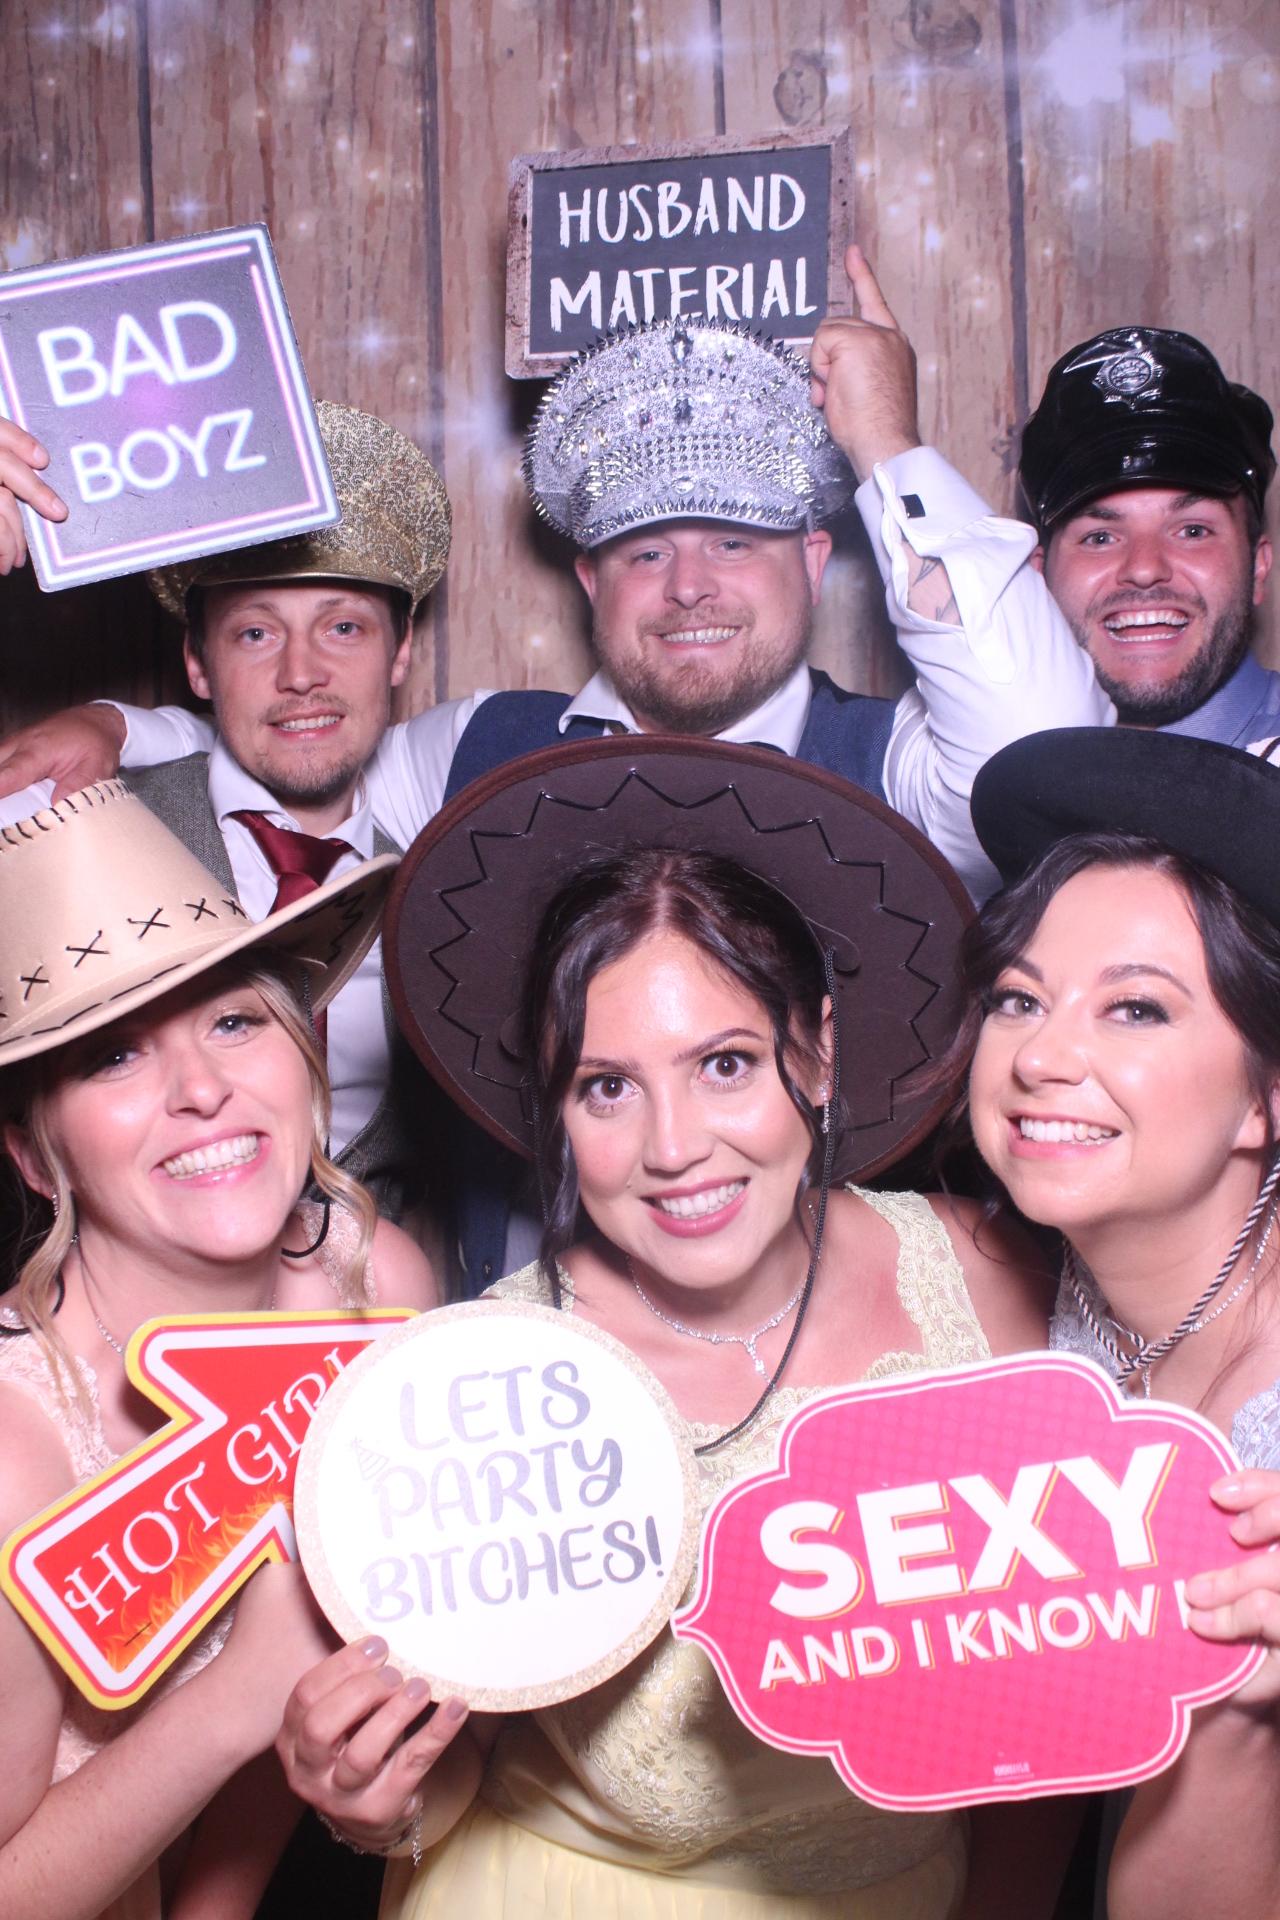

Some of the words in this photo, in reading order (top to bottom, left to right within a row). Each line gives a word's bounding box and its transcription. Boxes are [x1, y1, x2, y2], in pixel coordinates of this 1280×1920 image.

[559, 173, 806, 248] HUSBAND
[550, 257, 817, 333] MATERIAL
[37, 301, 237, 407] BAD
[70, 408, 267, 503] BOYZ
[400, 1360, 591, 1451] LETS
[371, 1438, 623, 1539] PARTY
[759, 1441, 1179, 1620] SEXY
[63, 1461, 220, 1625] HOT
[360, 1515, 664, 1624] BITCHES!
[759, 1626, 900, 1691] AND
[912, 1618, 936, 1670] I
[946, 1584, 1160, 1665] KNOW
